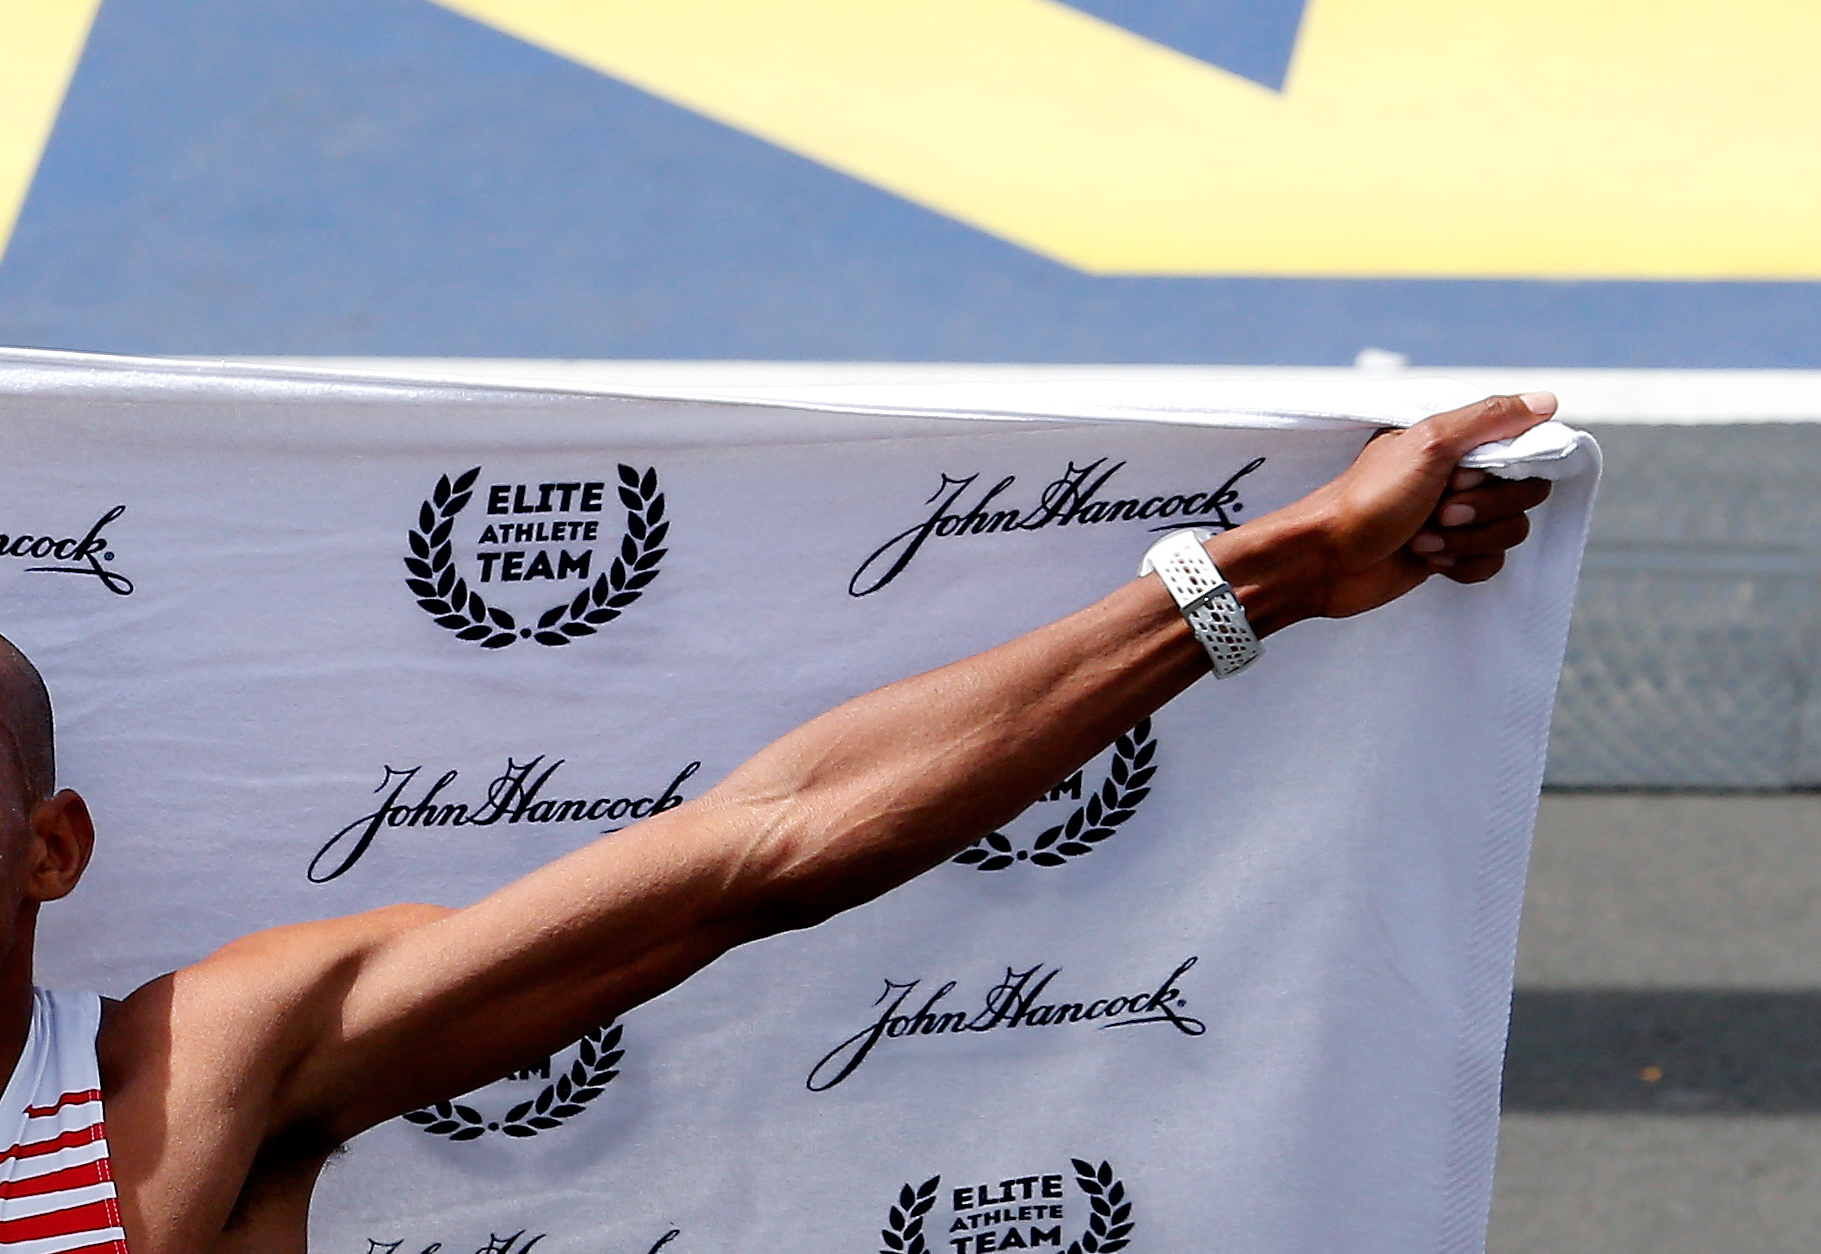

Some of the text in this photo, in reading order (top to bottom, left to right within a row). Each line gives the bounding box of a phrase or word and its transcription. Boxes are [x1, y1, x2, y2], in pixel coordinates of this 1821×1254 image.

[486, 482, 605, 515] ELITE
[478, 521, 599, 544] ATHLETE
[848, 472, 1019, 597] John
[477, 550, 593, 583] TEAM
[307, 765, 469, 883] John
[806, 978, 968, 1091] John
[953, 1174, 1064, 1211] ELITE
[949, 1204, 1064, 1233] ATHLETE
